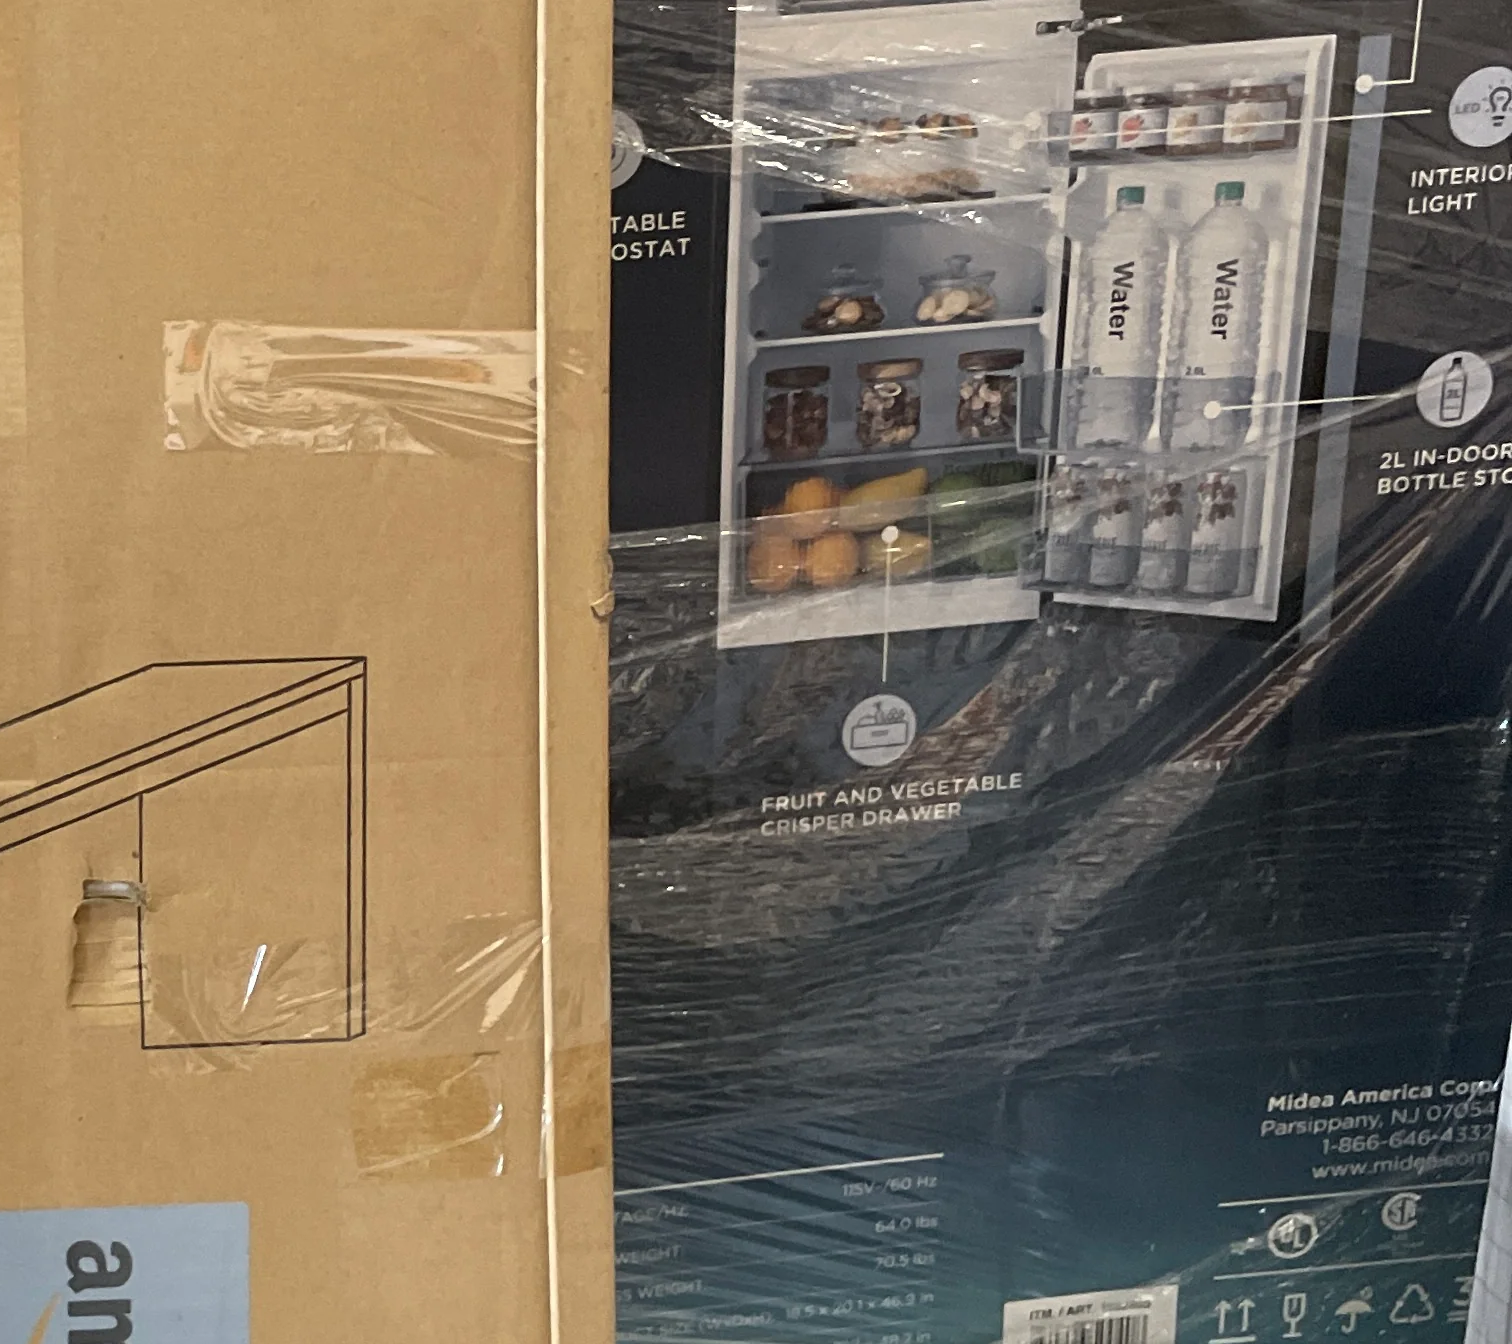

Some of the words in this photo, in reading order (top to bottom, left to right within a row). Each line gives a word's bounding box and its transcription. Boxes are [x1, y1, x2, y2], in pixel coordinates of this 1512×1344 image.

[1455, 102, 1481, 114] LED
[1407, 192, 1478, 215] LIGHT
[1106, 260, 1136, 341] Water
[1209, 258, 1240, 341] Water
[1379, 451, 1406, 470] 2L
[1413, 442, 1512, 467] IN-DOOR
[1377, 470, 1468, 495] BOTTLE
[761, 791, 826, 813] FRUIT
[833, 786, 882, 807] AND
[890, 772, 1023, 801] VEGETABLE
[760, 812, 854, 837] CRISPER
[862, 801, 962, 827] DRAWER
[1267, 1093, 1334, 1113] Midea
[1340, 1084, 1433, 1106] America
[1260, 1112, 1384, 1137] Parsippany,
[1390, 1108, 1423, 1125] NJ
[1425, 1101, 1496, 1122] 07054
[1322, 1123, 1495, 1155] 1-866-646-4332
